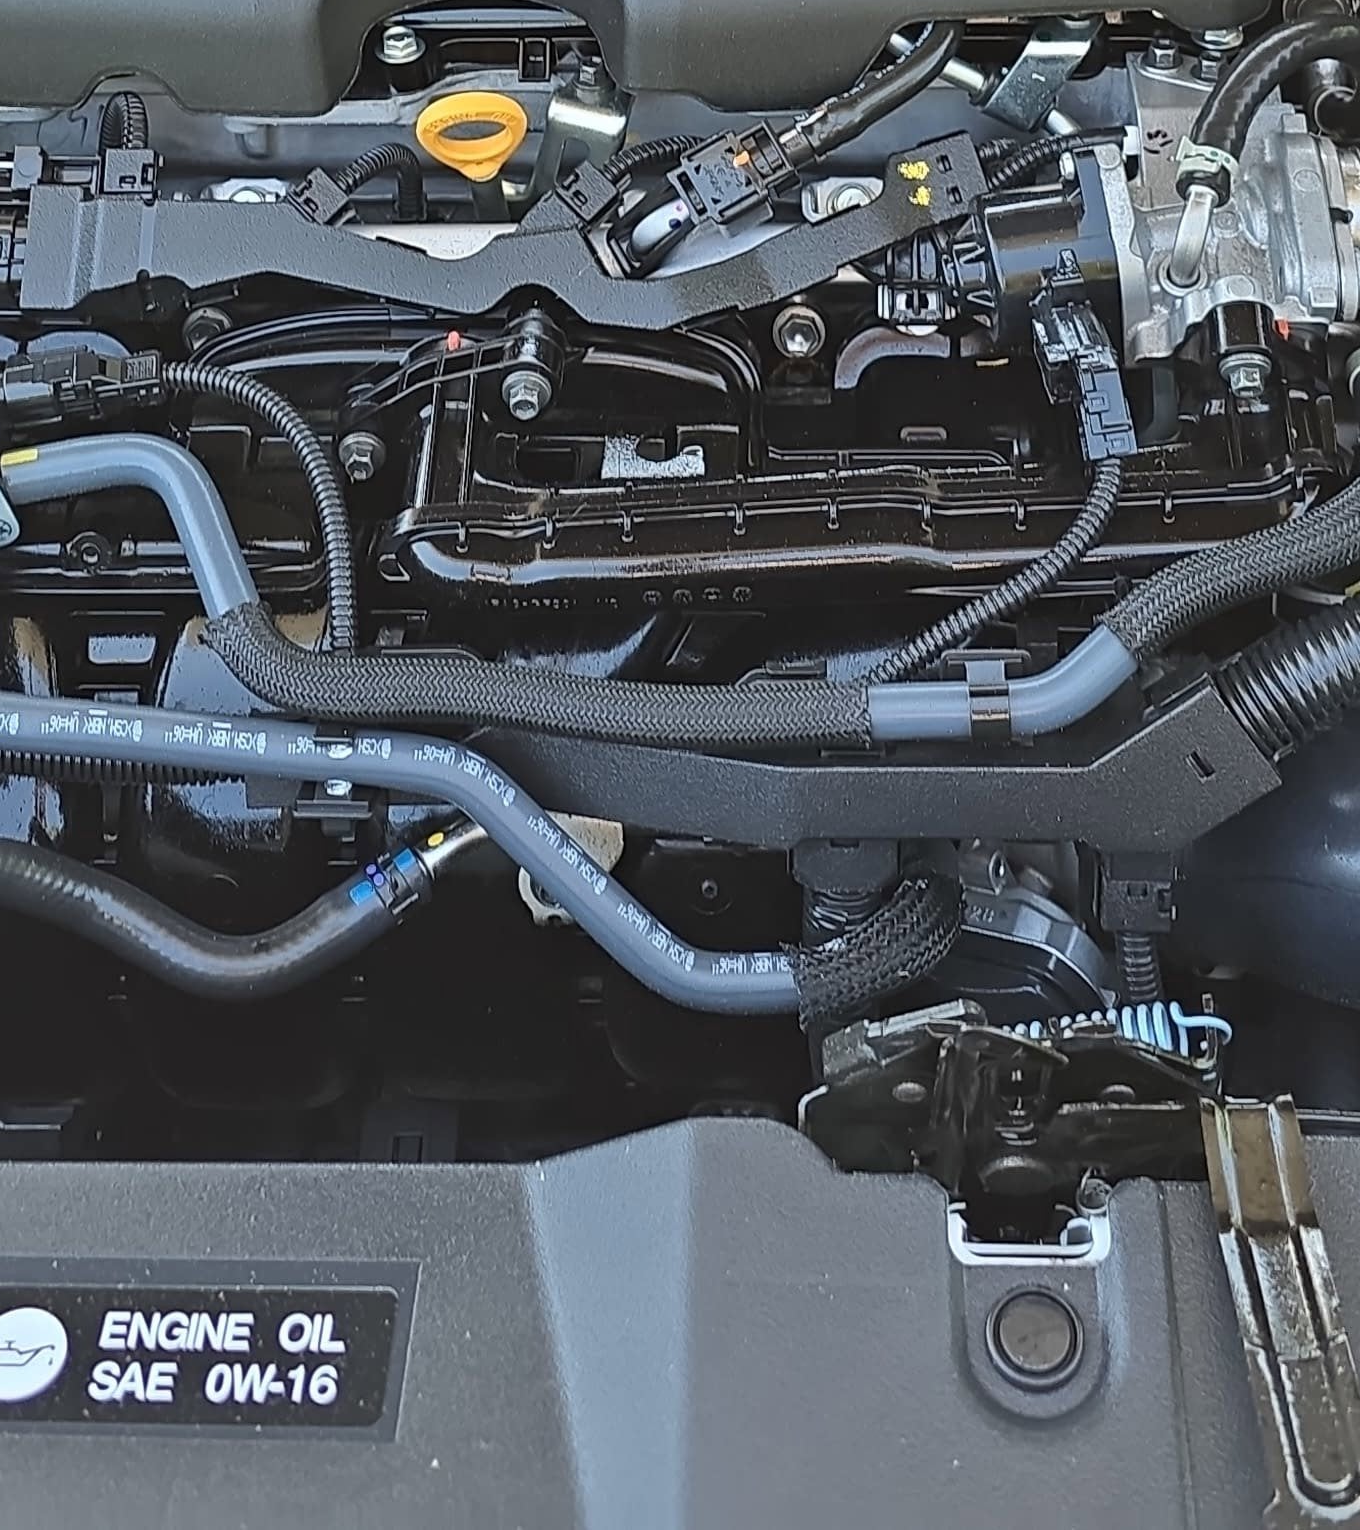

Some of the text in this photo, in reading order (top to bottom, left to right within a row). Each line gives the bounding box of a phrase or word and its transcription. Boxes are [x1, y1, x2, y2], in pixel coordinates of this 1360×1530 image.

[98, 1311, 345, 1353] ENGINE OIL
[88, 1362, 338, 1406] SAE 0W-16
